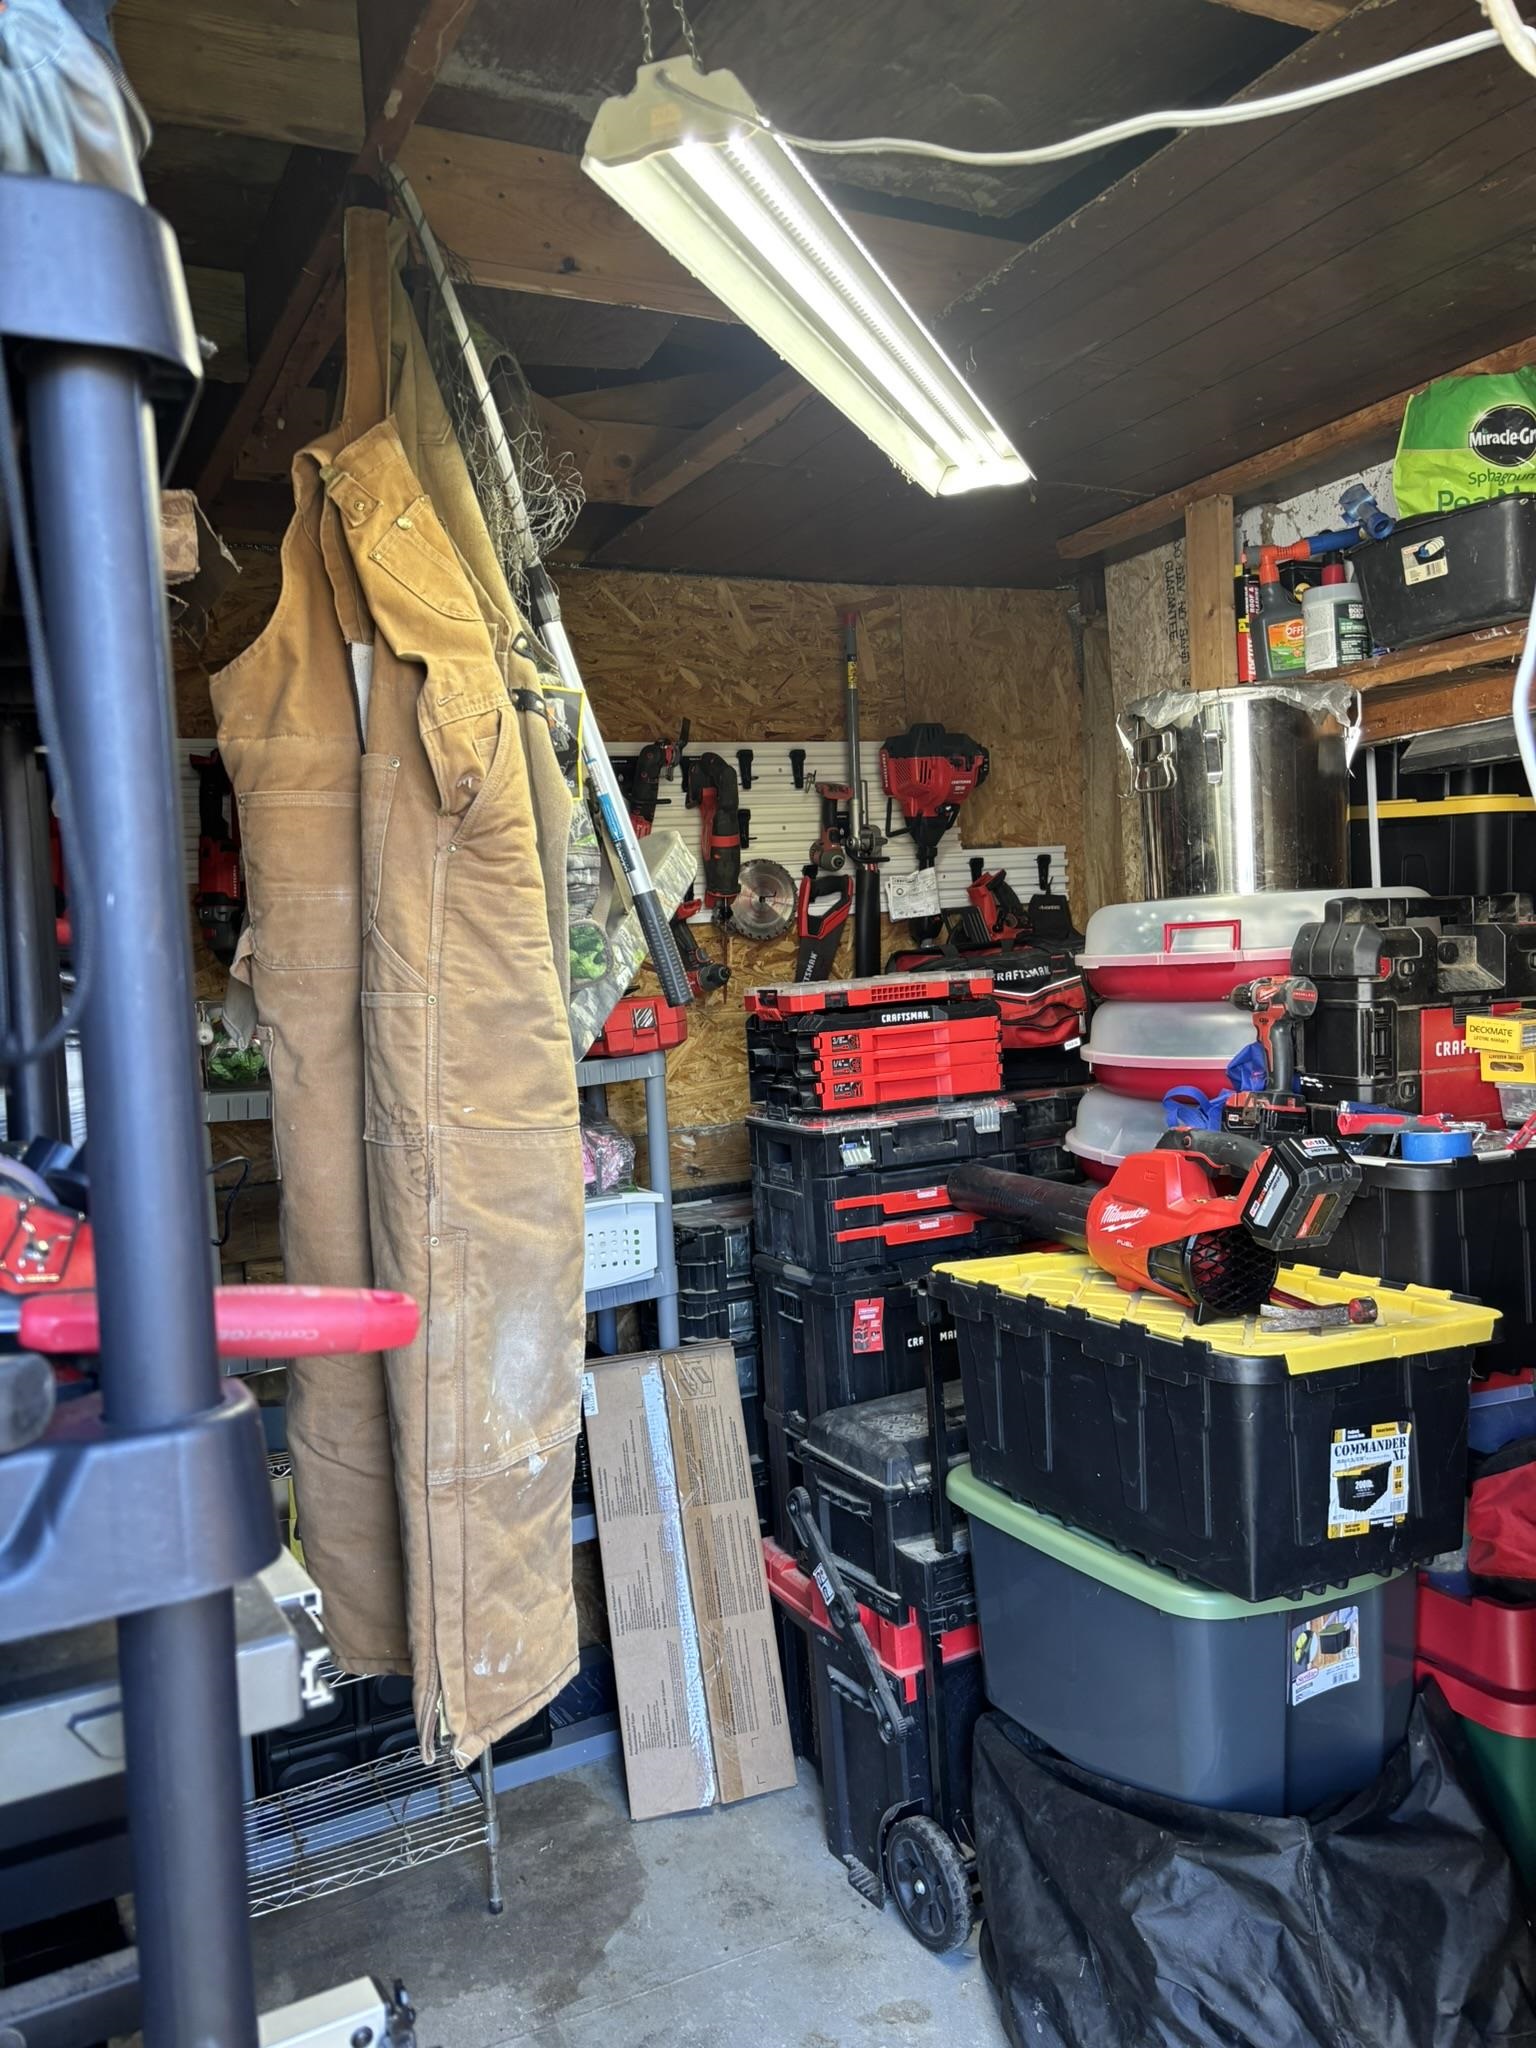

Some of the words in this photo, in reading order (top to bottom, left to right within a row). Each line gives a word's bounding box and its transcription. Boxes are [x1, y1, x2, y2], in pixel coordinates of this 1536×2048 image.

[1469, 427, 1536, 448] Miracle-Gr
[1164, 560, 1178, 642] GUARANTEE
[803, 952, 817, 984] TSMAN
[996, 965, 1051, 981] RAFTSMAN
[881, 1011, 930, 1023] CRAFTSMAN
[1469, 1025, 1513, 1037] DECKMATE
[1101, 1203, 1149, 1224] Milwaukee
[1334, 1437, 1407, 1457] COMMANDER
[1393, 1449, 1406, 1461] XL
